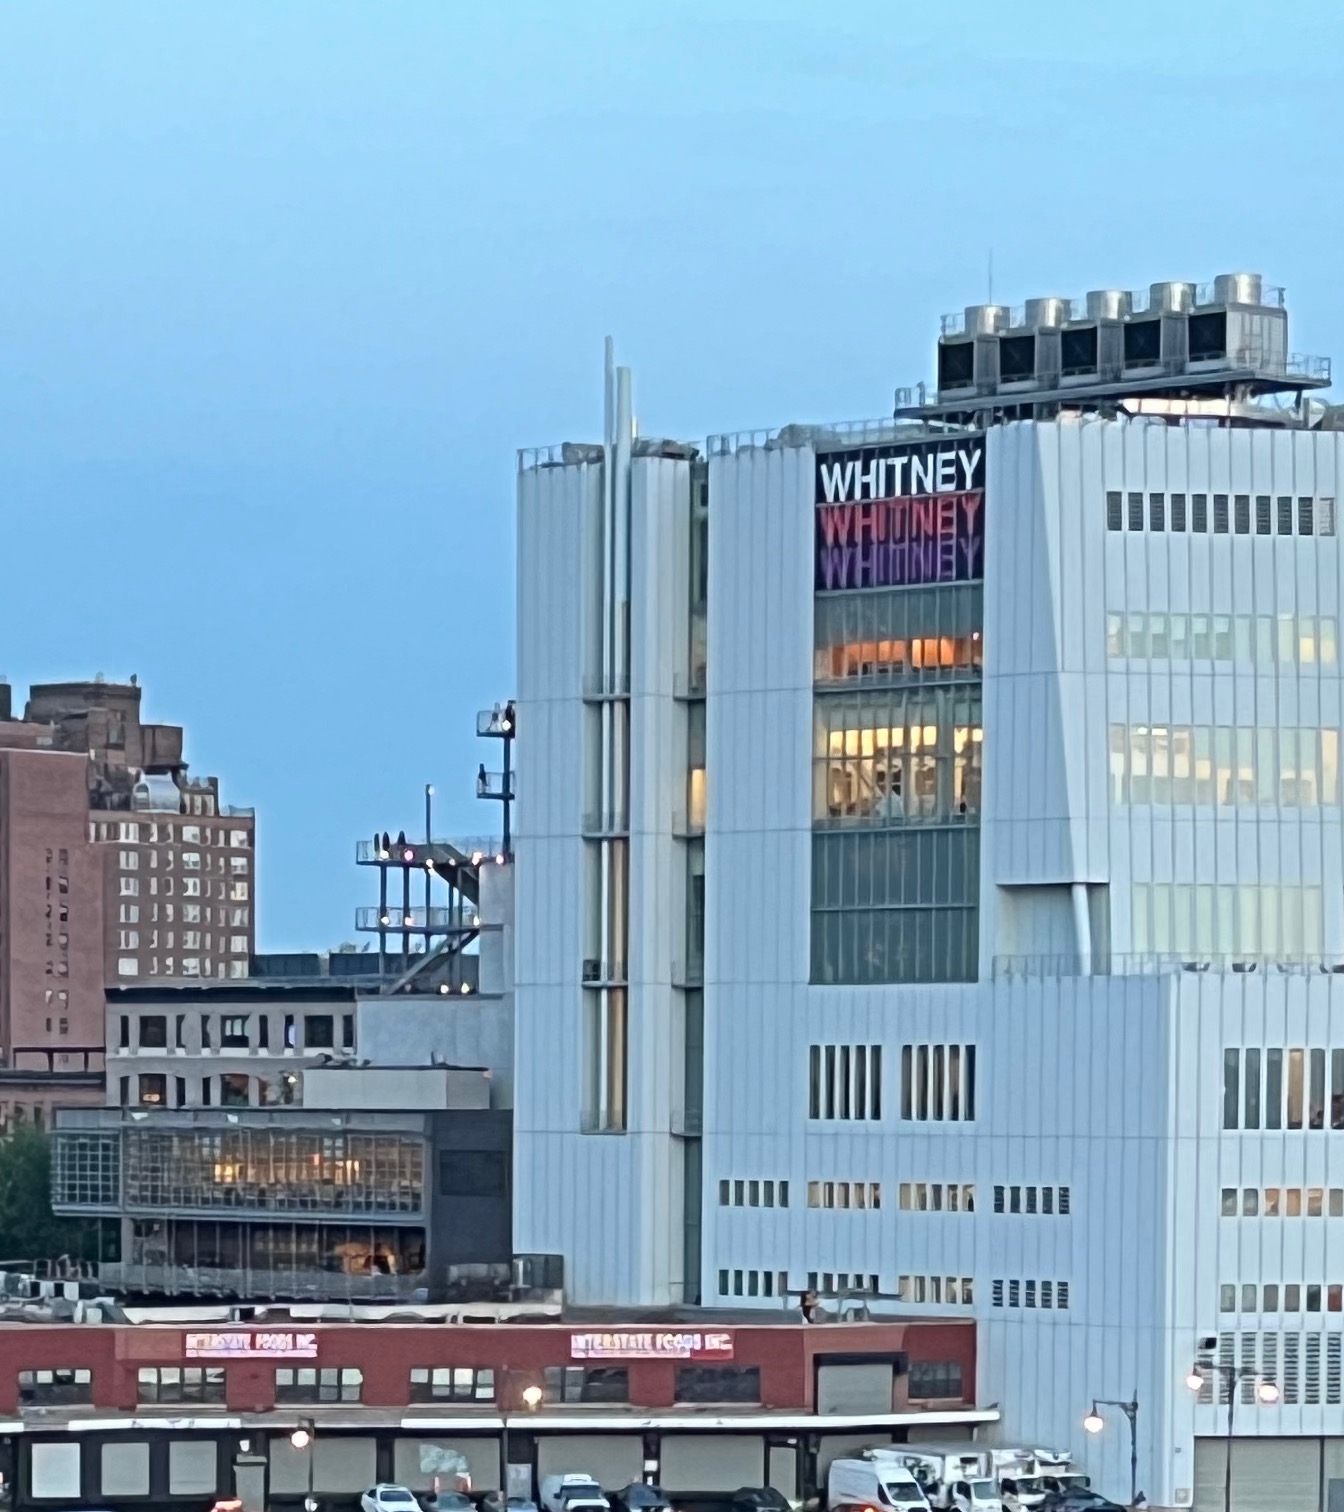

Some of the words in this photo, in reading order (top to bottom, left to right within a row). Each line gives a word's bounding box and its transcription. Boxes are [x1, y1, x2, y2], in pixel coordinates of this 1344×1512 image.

[820, 449, 981, 503] WHITNEY
[820, 493, 981, 548] WHITNEY
[820, 536, 981, 590] WHITNEY
